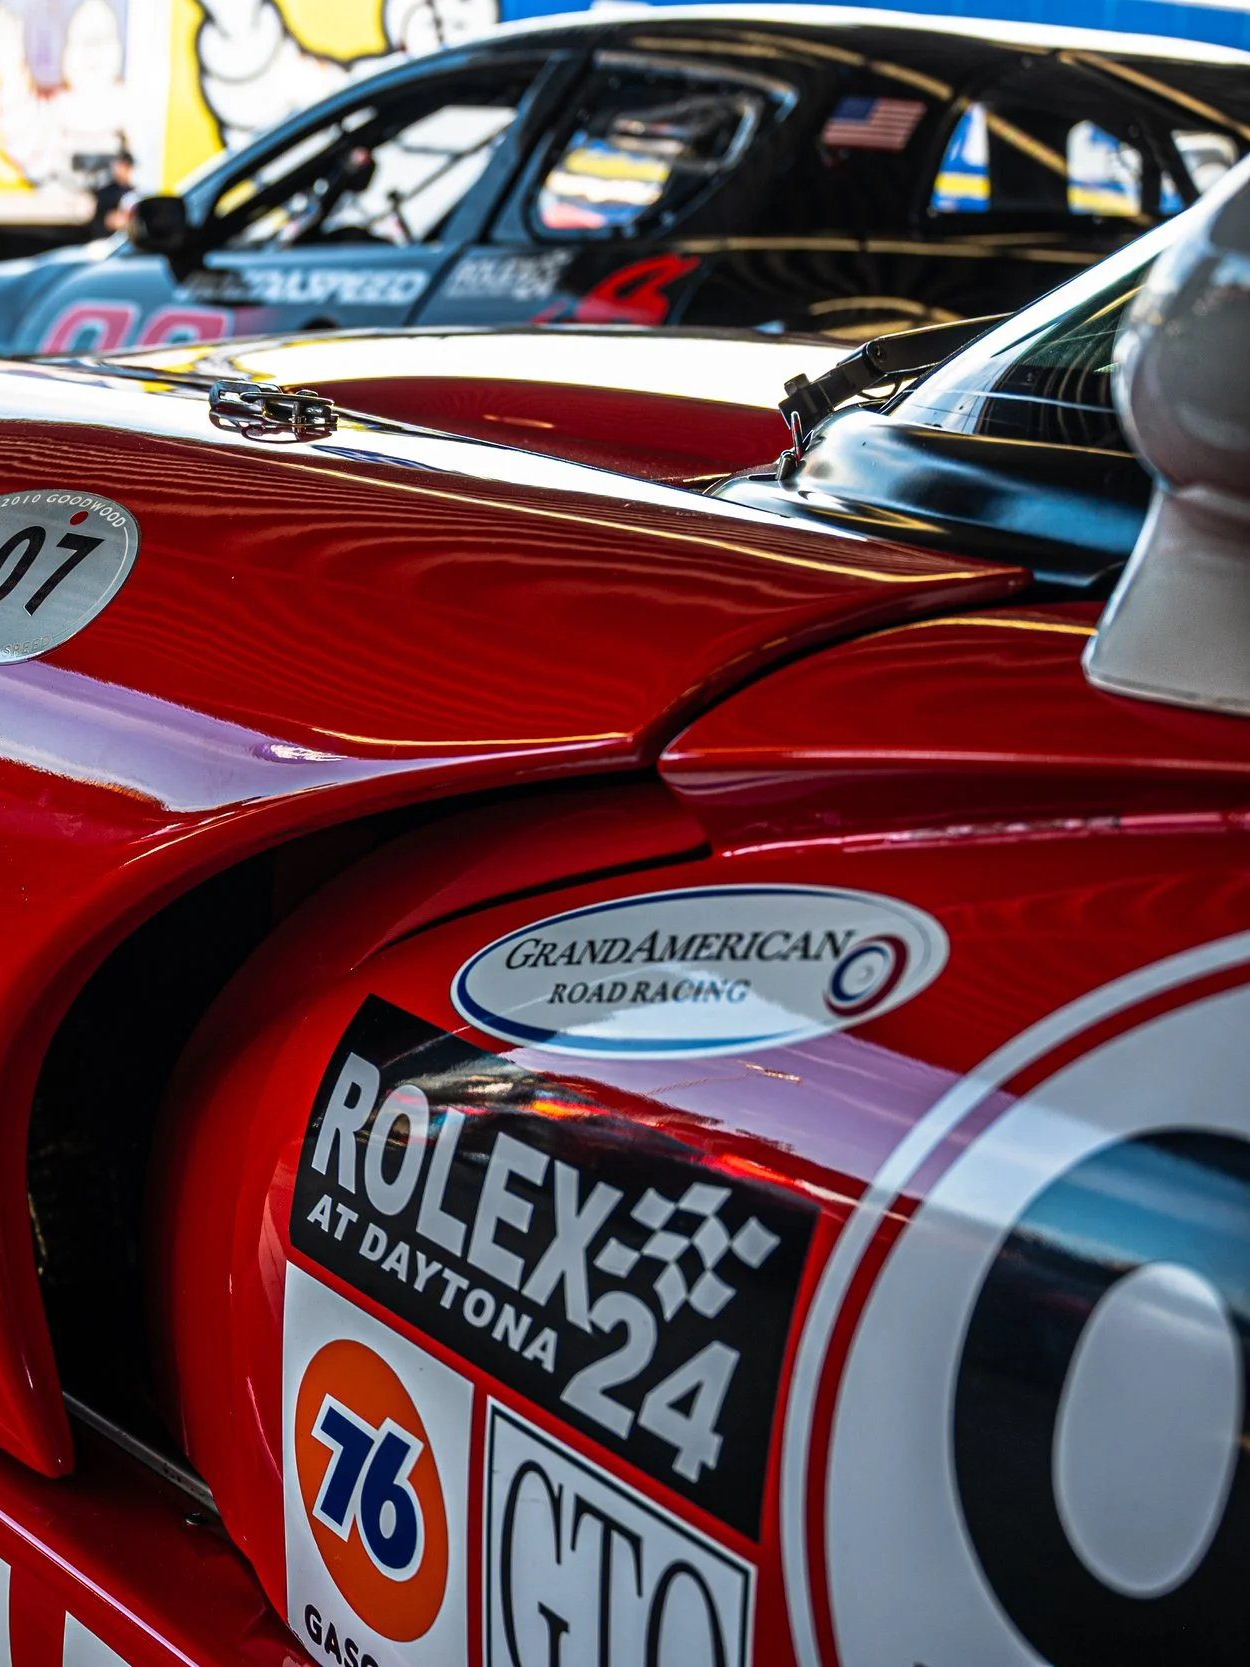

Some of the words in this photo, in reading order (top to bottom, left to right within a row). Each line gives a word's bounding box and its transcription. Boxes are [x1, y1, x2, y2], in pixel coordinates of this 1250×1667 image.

[1, 494, 41, 507] 2010
[47, 494, 126, 528] GOODWOOD
[549, 981, 626, 1005] ROAD
[631, 978, 751, 1005] RACING
[311, 1051, 624, 1334] ROLEX
[307, 1194, 358, 1241] AT
[358, 1223, 559, 1374] DAYTONA
[560, 1291, 740, 1483] 24
[314, 1397, 422, 1578] 76
